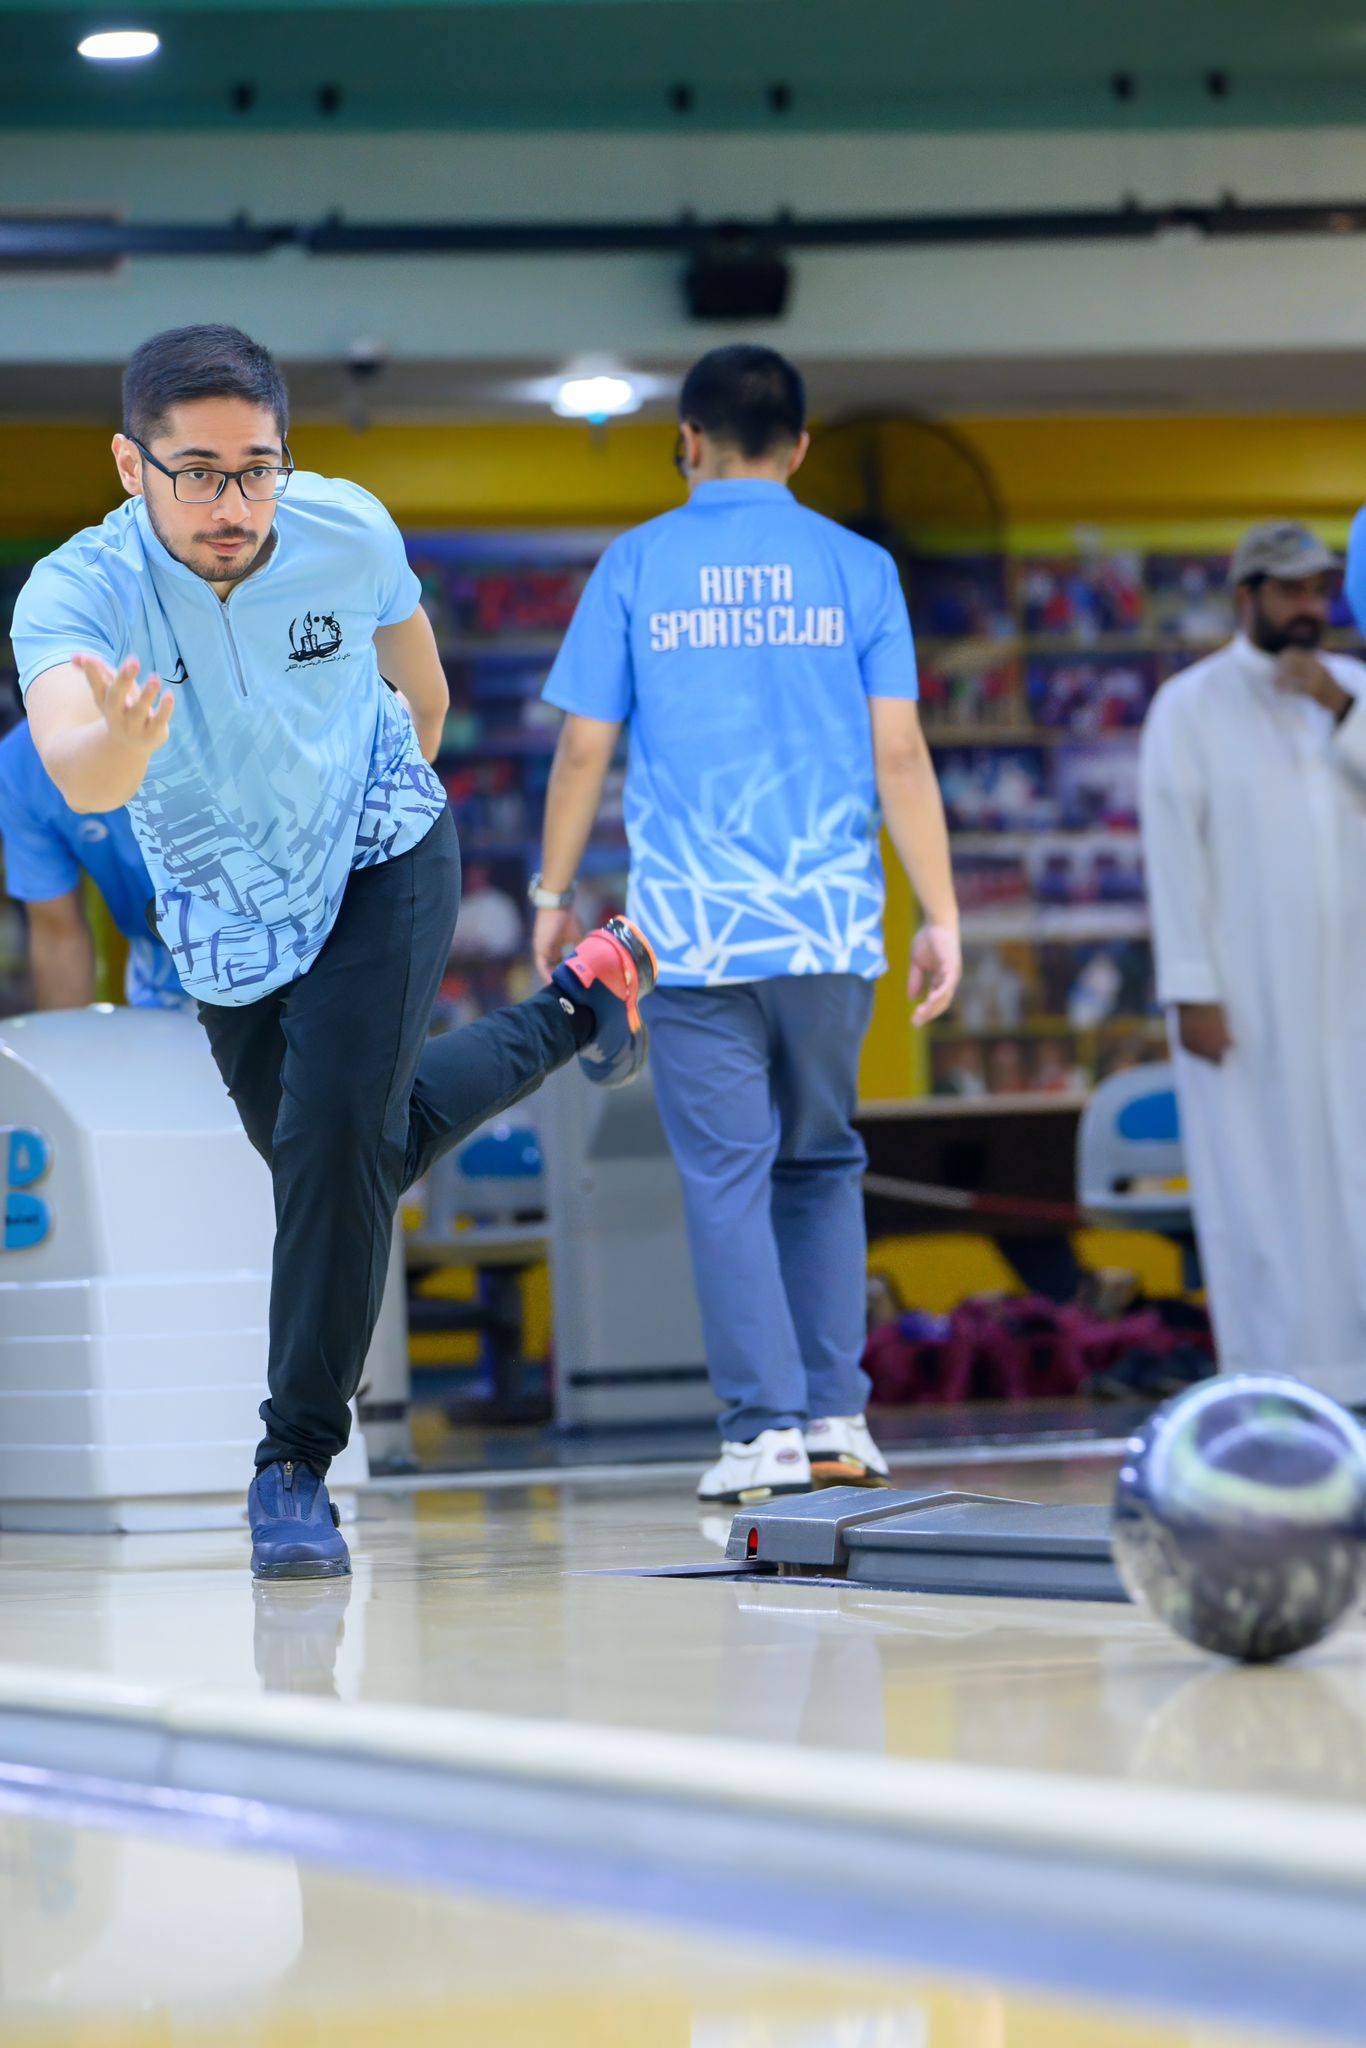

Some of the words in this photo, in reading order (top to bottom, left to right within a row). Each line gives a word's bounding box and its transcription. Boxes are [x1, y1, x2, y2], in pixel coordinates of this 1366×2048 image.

[699, 563, 793, 605] RIFFA
[650, 606, 763, 652] SPORTS
[766, 605, 845, 647] CLUB
